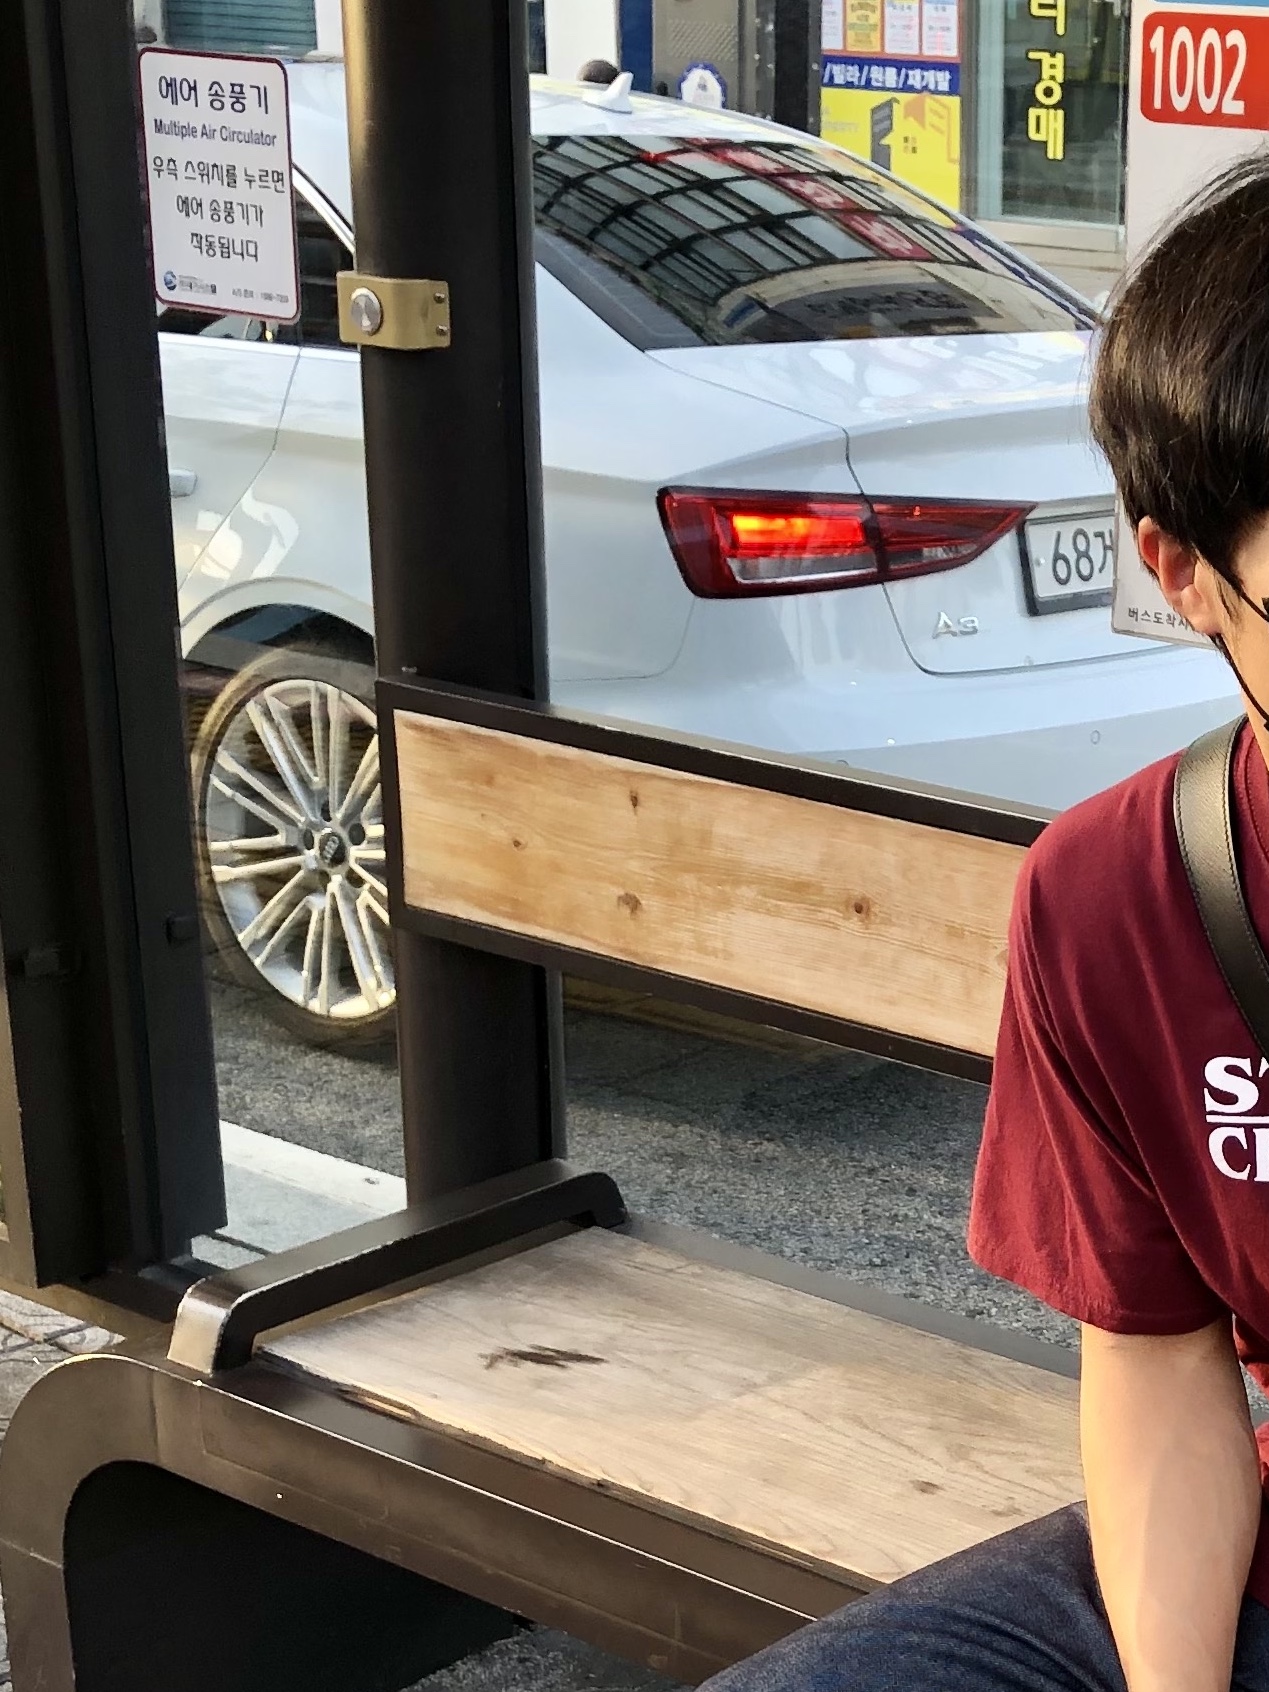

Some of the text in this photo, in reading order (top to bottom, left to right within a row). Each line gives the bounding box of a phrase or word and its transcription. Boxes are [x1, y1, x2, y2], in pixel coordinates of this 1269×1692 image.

[1149, 25, 1247, 115] 1002
[158, 75, 269, 115] 에어 송풍기
[1027, 51, 1065, 160] 경매
[153, 118, 278, 147] Multiple Air Circulator
[153, 155, 286, 194] 우측 스위치를 누르면
[176, 194, 264, 228] 에어 송풍기가
[190, 231, 259, 263] 작동됩니다
[931, 611, 979, 640] A3
